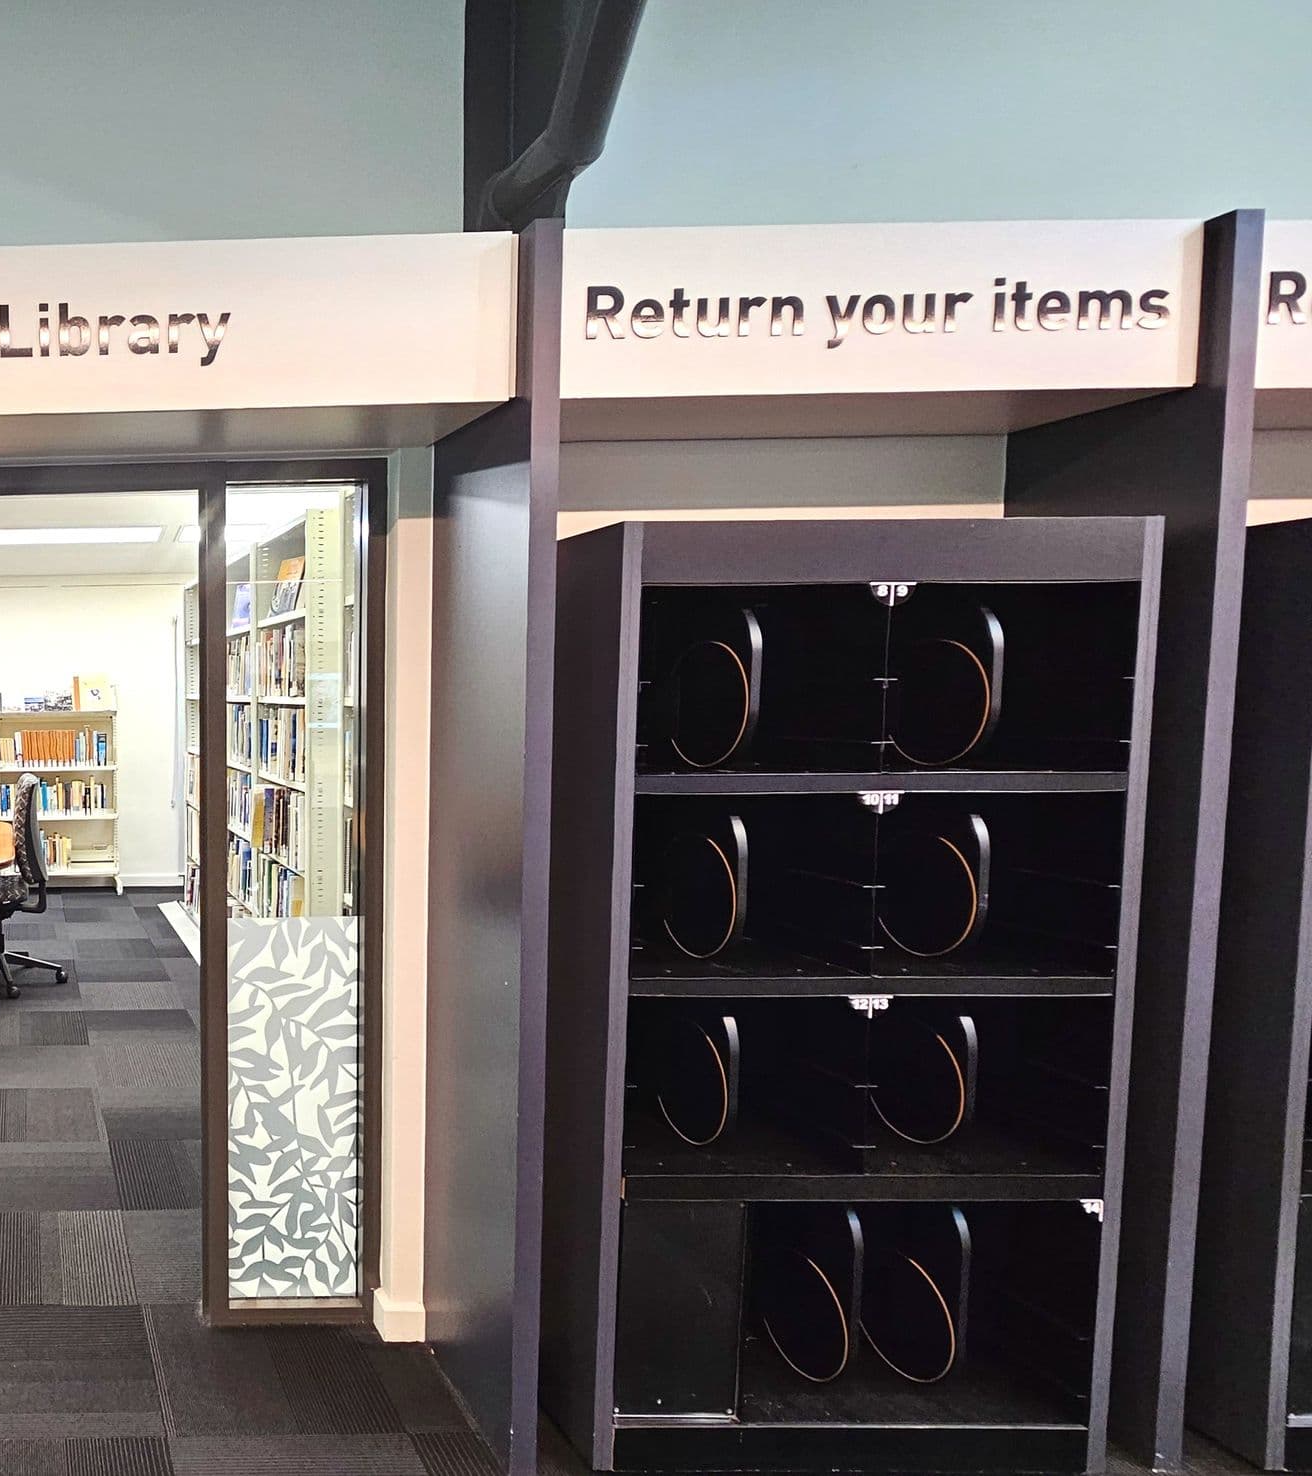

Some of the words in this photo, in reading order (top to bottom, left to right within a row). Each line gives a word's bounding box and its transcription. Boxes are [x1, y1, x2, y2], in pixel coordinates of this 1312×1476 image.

[1266, 270, 1312, 325] R
[585, 284, 805, 341] Return
[825, 289, 975, 349] your
[992, 277, 1170, 333] items
[877, 584, 889, 597] 8
[896, 584, 909, 597] 9
[862, 793, 880, 805] 10
[884, 793, 899, 805] 11
[851, 999, 869, 1010] 12
[873, 999, 889, 1010] 13
